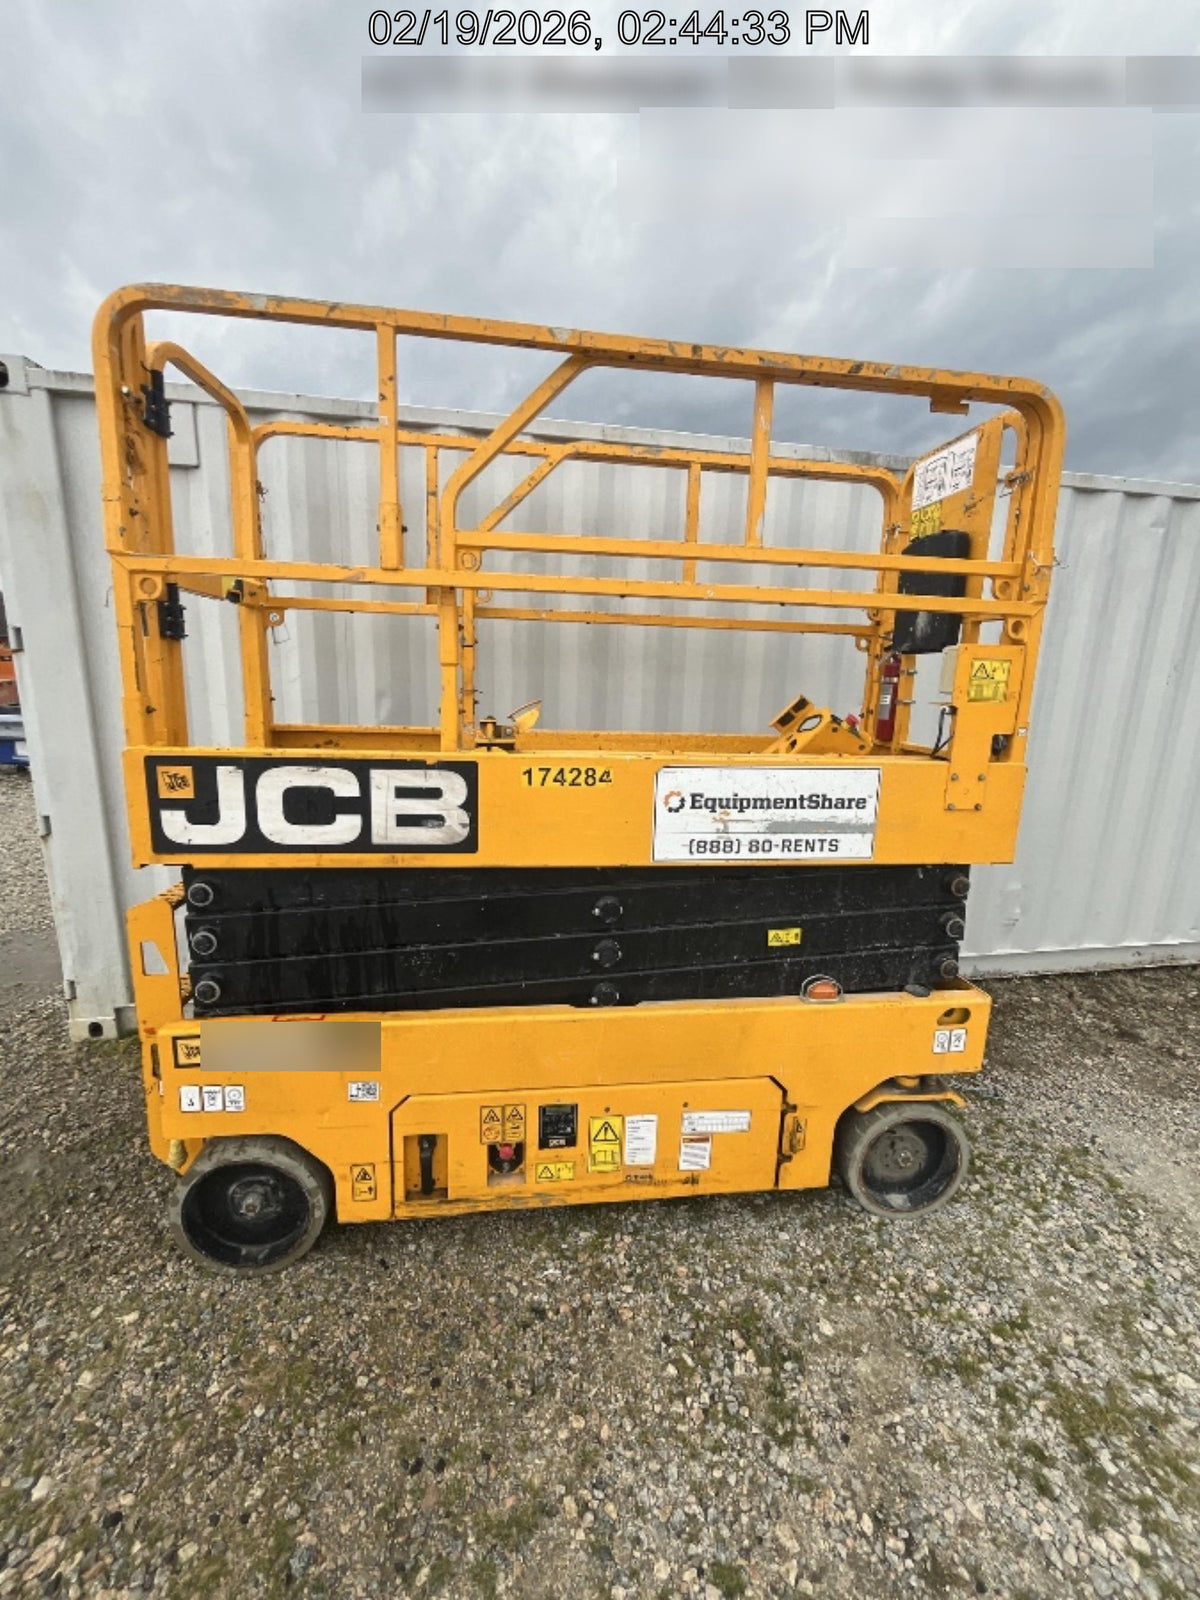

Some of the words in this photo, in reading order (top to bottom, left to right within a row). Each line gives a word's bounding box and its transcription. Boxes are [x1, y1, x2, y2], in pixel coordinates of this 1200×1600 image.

[522, 767, 612, 786] 174284
[160, 766, 470, 845] JCB
[689, 793, 867, 813] EquipmentShare
[688, 839, 741, 855] (888)
[749, 838, 839, 853] 80-RENTS
